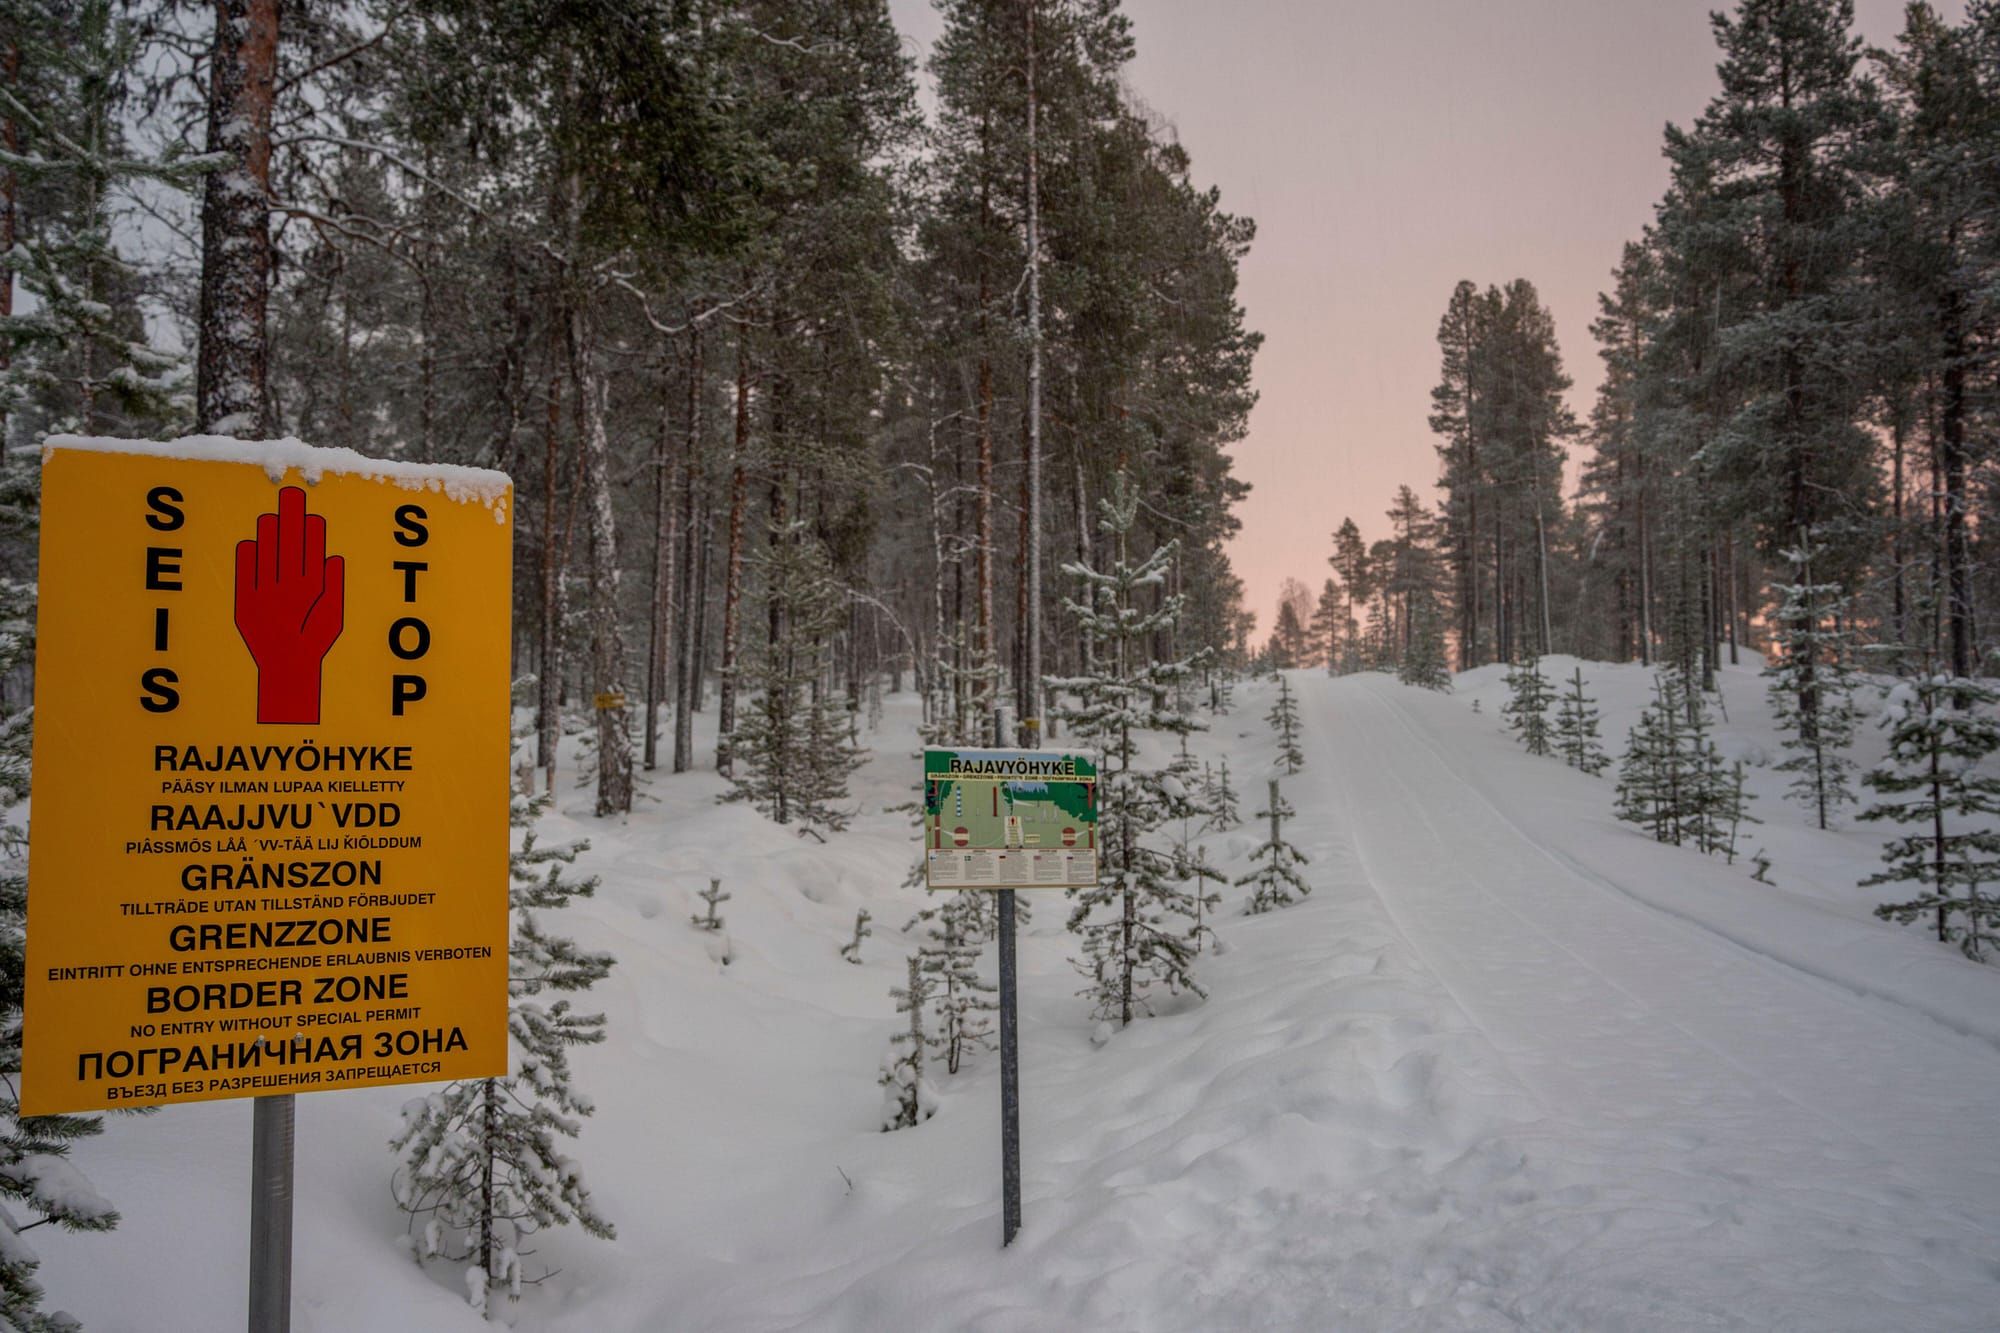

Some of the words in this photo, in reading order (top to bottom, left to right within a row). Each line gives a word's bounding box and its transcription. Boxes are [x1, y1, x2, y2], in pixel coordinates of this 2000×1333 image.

[140, 486, 185, 713] SEIS
[388, 504, 431, 716] STOP
[154, 739, 413, 772] RAJAVYÖHYKE
[950, 757, 1074, 776] RAJAVYÖHYKE
[162, 778, 215, 794] PÄÄSY
[220, 780, 268, 793] ILMAN
[273, 781, 323, 793] LUPAA
[328, 780, 405, 792] KIELLETTY
[217, 836, 247, 852] LÅÅ
[318, 838, 339, 850] LIJ
[181, 857, 382, 892] GRÄNSZON
[120, 899, 209, 916] TILLTRÄDE
[214, 899, 256, 912] UTAN
[348, 892, 437, 908] FÖRBJUDET
[169, 917, 392, 952] GRENZZONE
[48, 965, 125, 981] EINTRITT
[129, 962, 177, 977] OHNE
[182, 956, 322, 974] ENTSPRECHENDE
[326, 951, 411, 967] ERLAUBNIS
[415, 946, 492, 962] VERBOTEN
[146, 980, 303, 1014] BORDER
[313, 973, 409, 1005] ZONE
[130, 1024, 156, 1038] NO
[160, 1020, 215, 1036] ENTRY
[219, 1015, 293, 1033] WITHOUT
[296, 1010, 362, 1028] SPECIAL
[365, 1007, 422, 1023] PERMIT
[78, 1034, 363, 1081] ПОГРАНИЧНАЯ
[373, 1026, 469, 1058] ЗОНА
[107, 1083, 168, 1100] ВЪЕЗД
[172, 1081, 204, 1094] БЕЗ
[209, 1071, 321, 1092] РАЗРЕШЕНИЯ
[325, 1061, 442, 1082] ЗАПРЕЩАЕТСЯ
